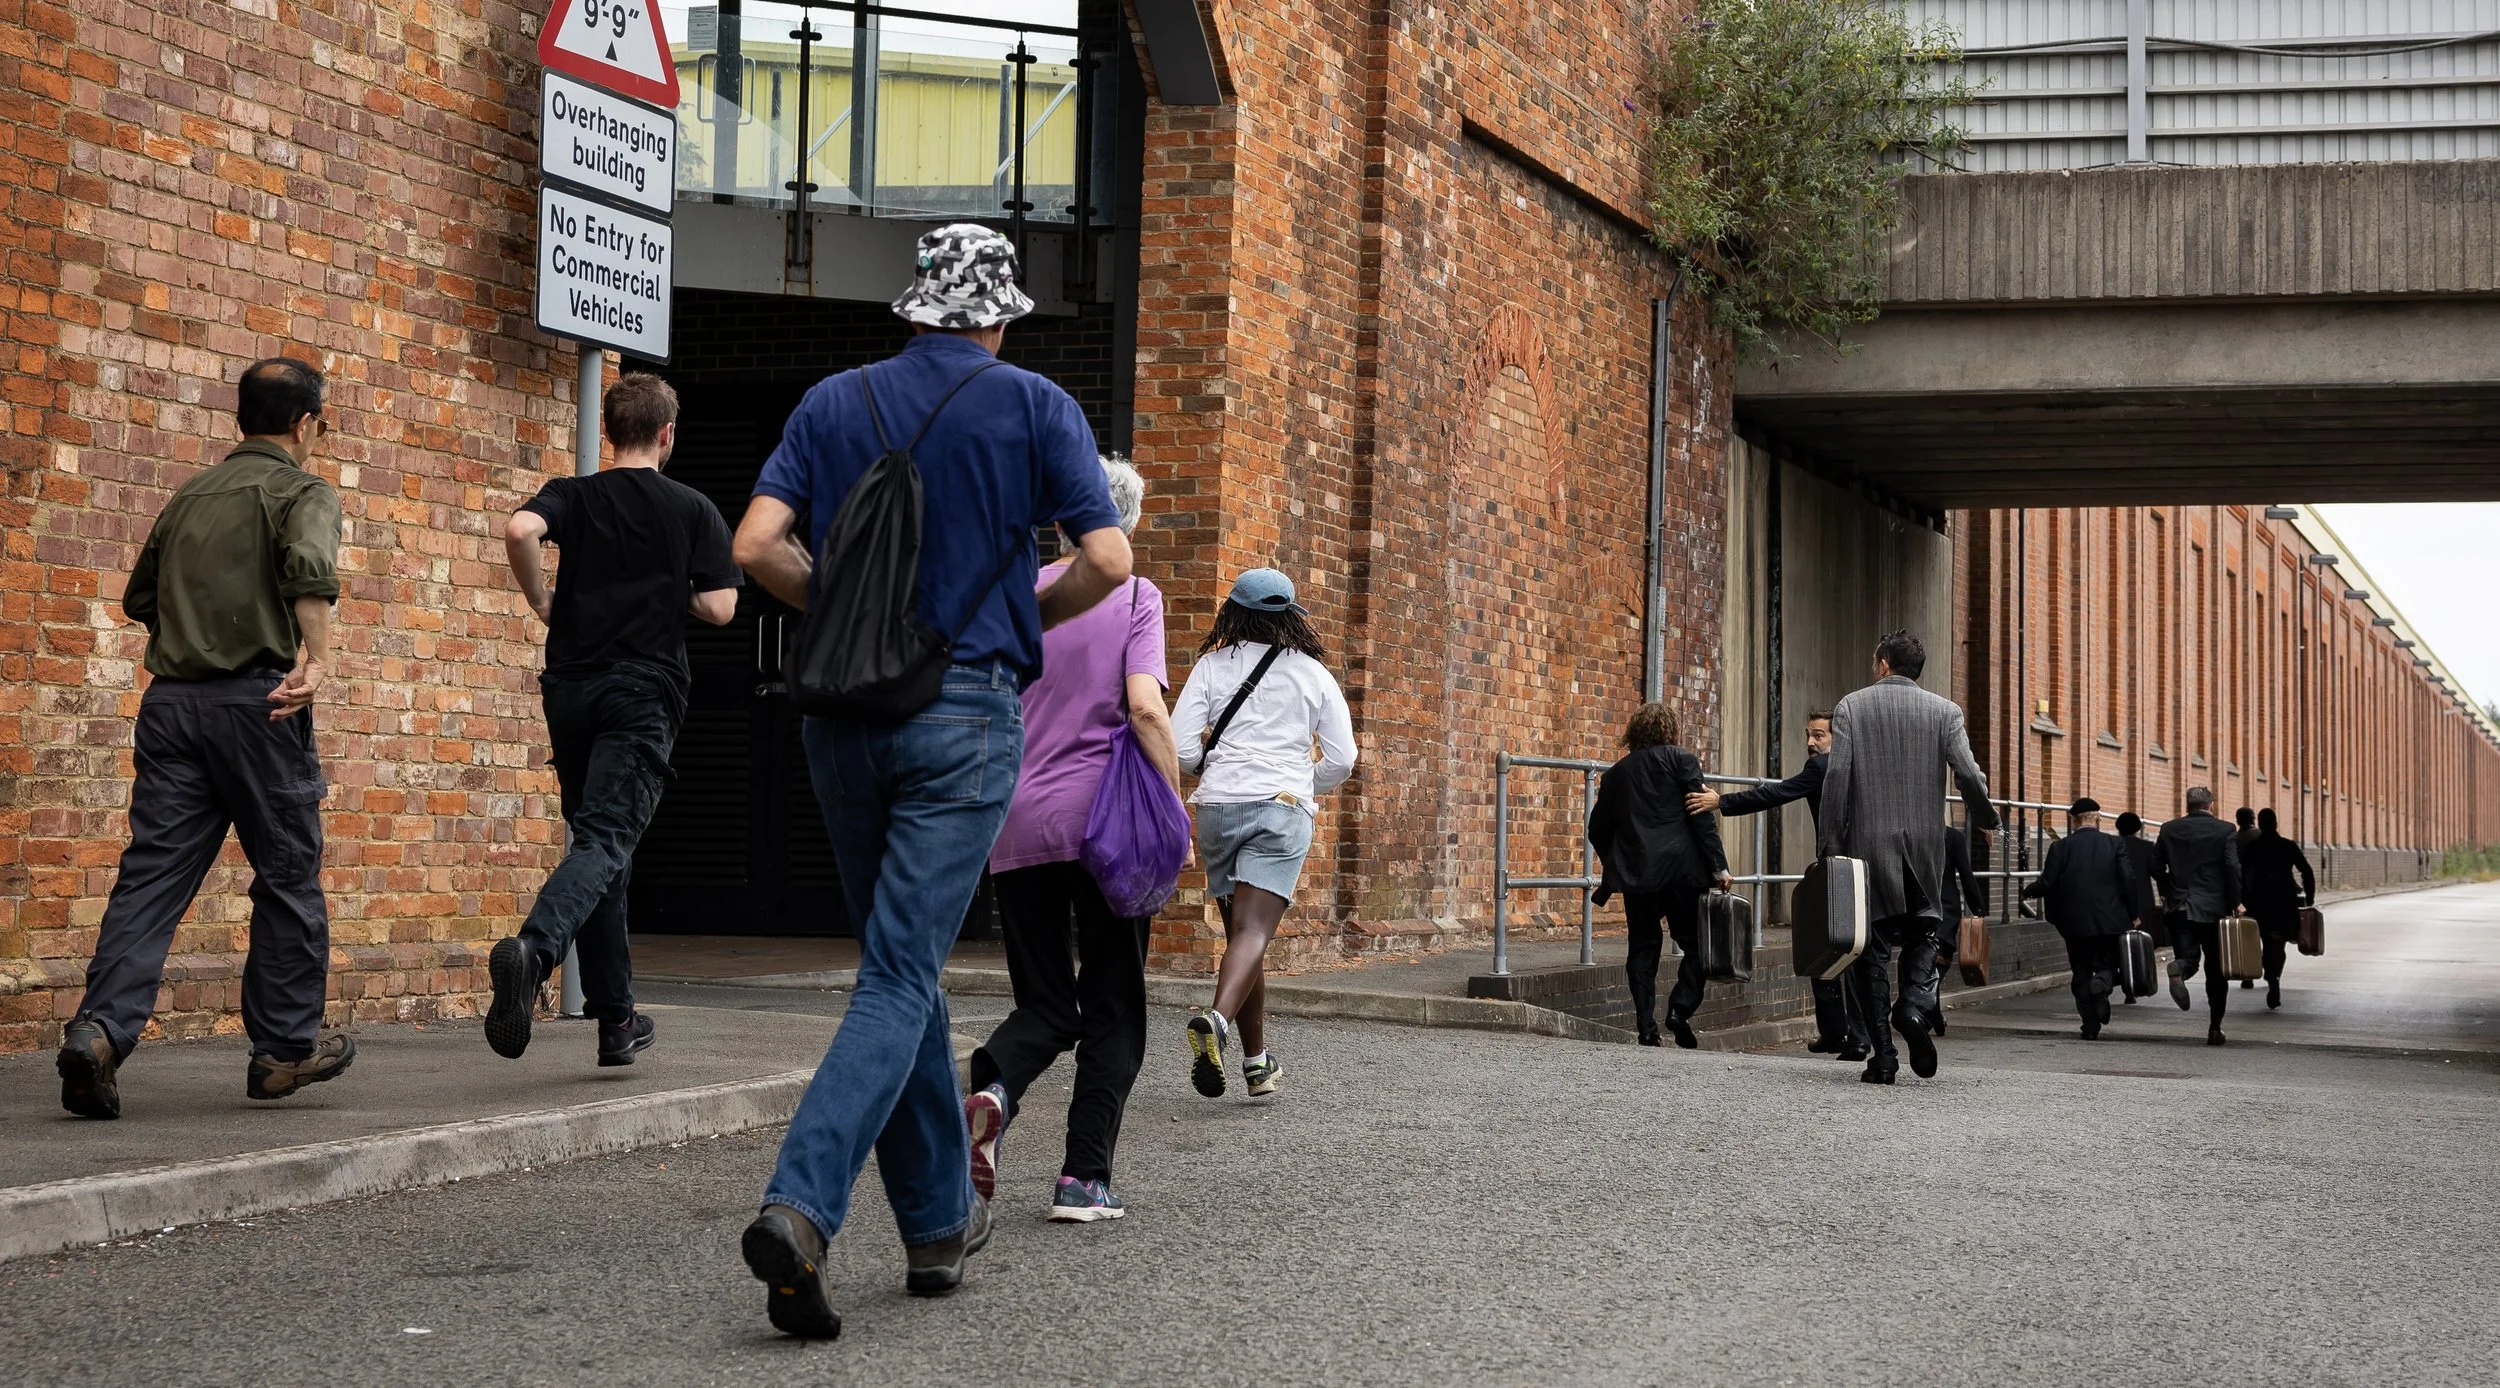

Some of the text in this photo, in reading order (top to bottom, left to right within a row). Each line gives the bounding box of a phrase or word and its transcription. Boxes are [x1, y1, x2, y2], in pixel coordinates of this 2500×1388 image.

[552, 90, 667, 163] Overhanging
[573, 136, 645, 193] building
[550, 203, 665, 265] No Entry for
[552, 244, 661, 303] Commercial
[569, 287, 643, 335] Vehicles
